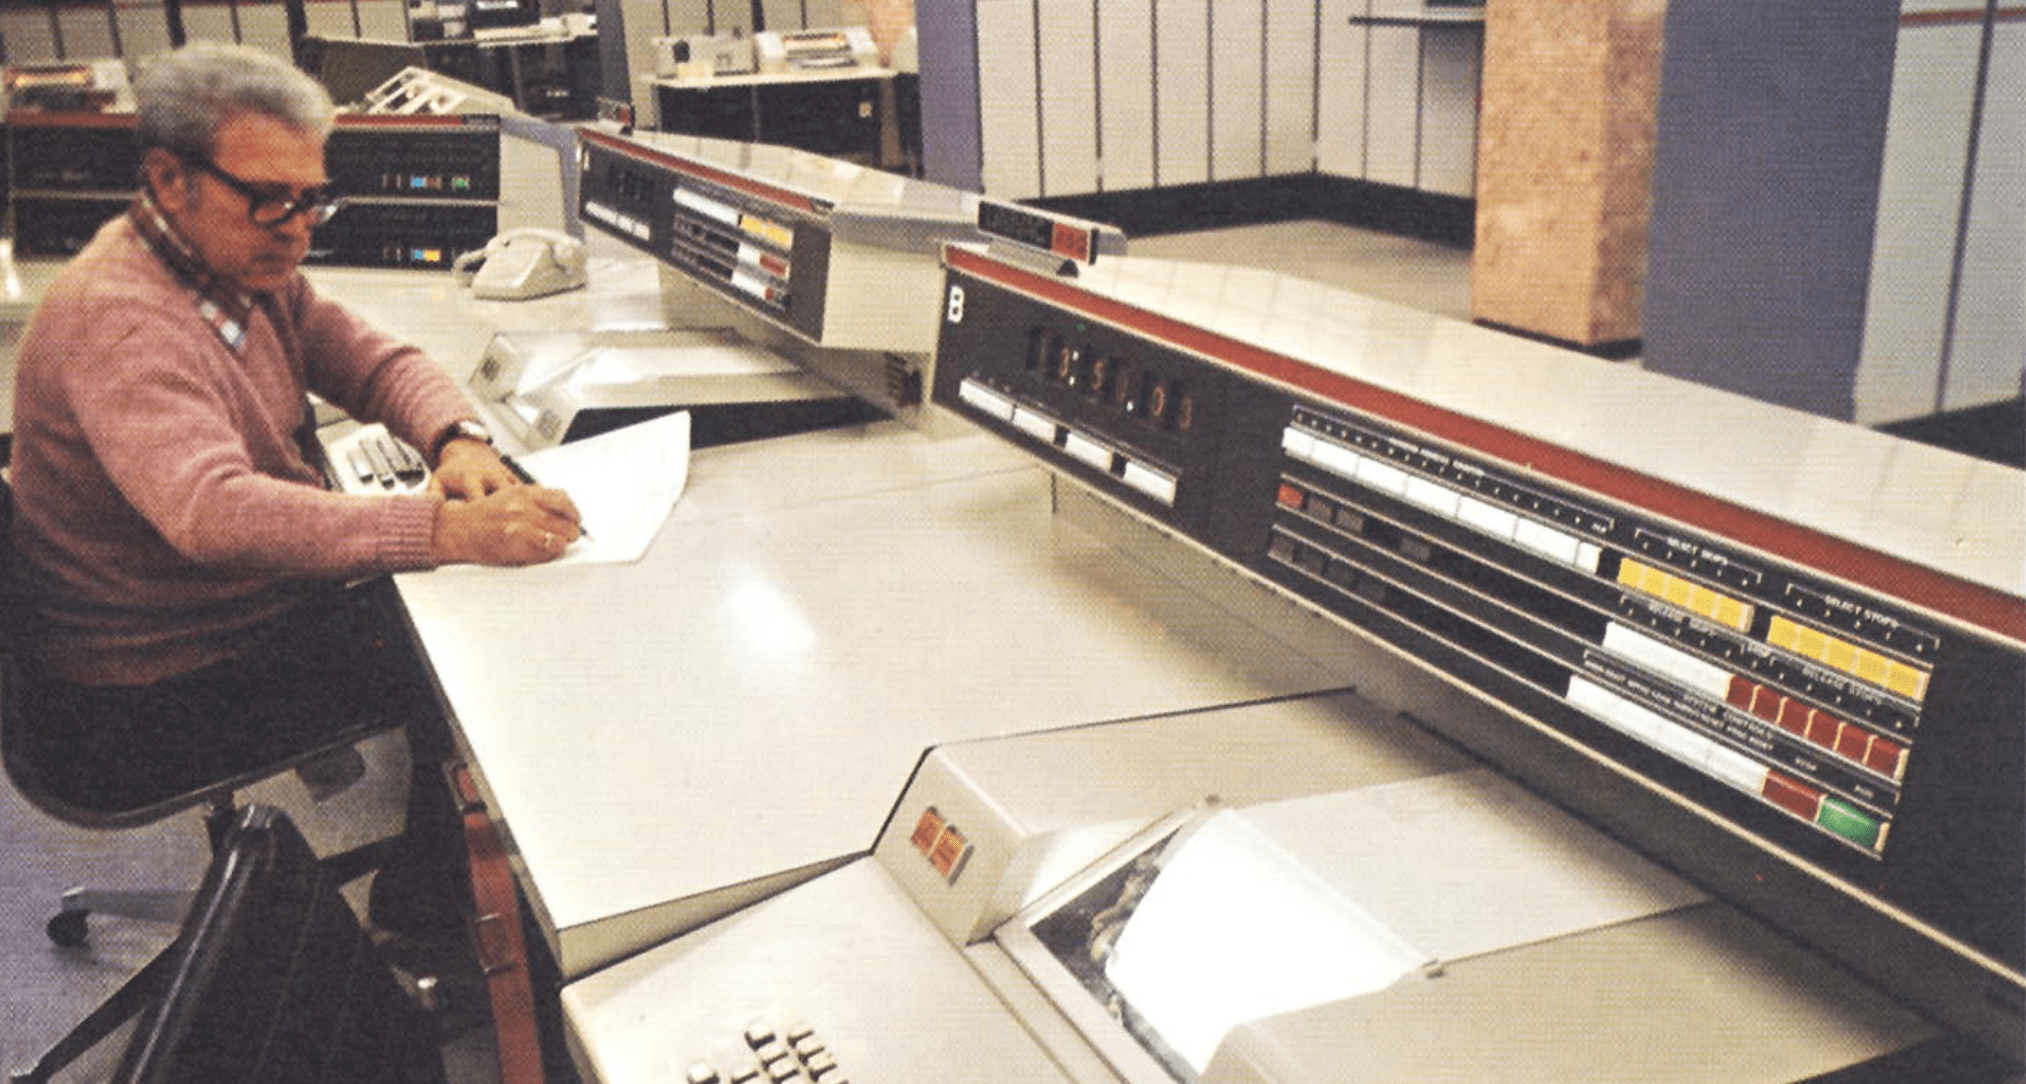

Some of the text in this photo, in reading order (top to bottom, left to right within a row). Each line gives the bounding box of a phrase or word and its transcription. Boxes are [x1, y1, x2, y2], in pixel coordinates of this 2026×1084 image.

[948, 285, 965, 323] B
[1824, 594, 1862, 615] SELECT
[1864, 608, 1900, 630] STOPS
